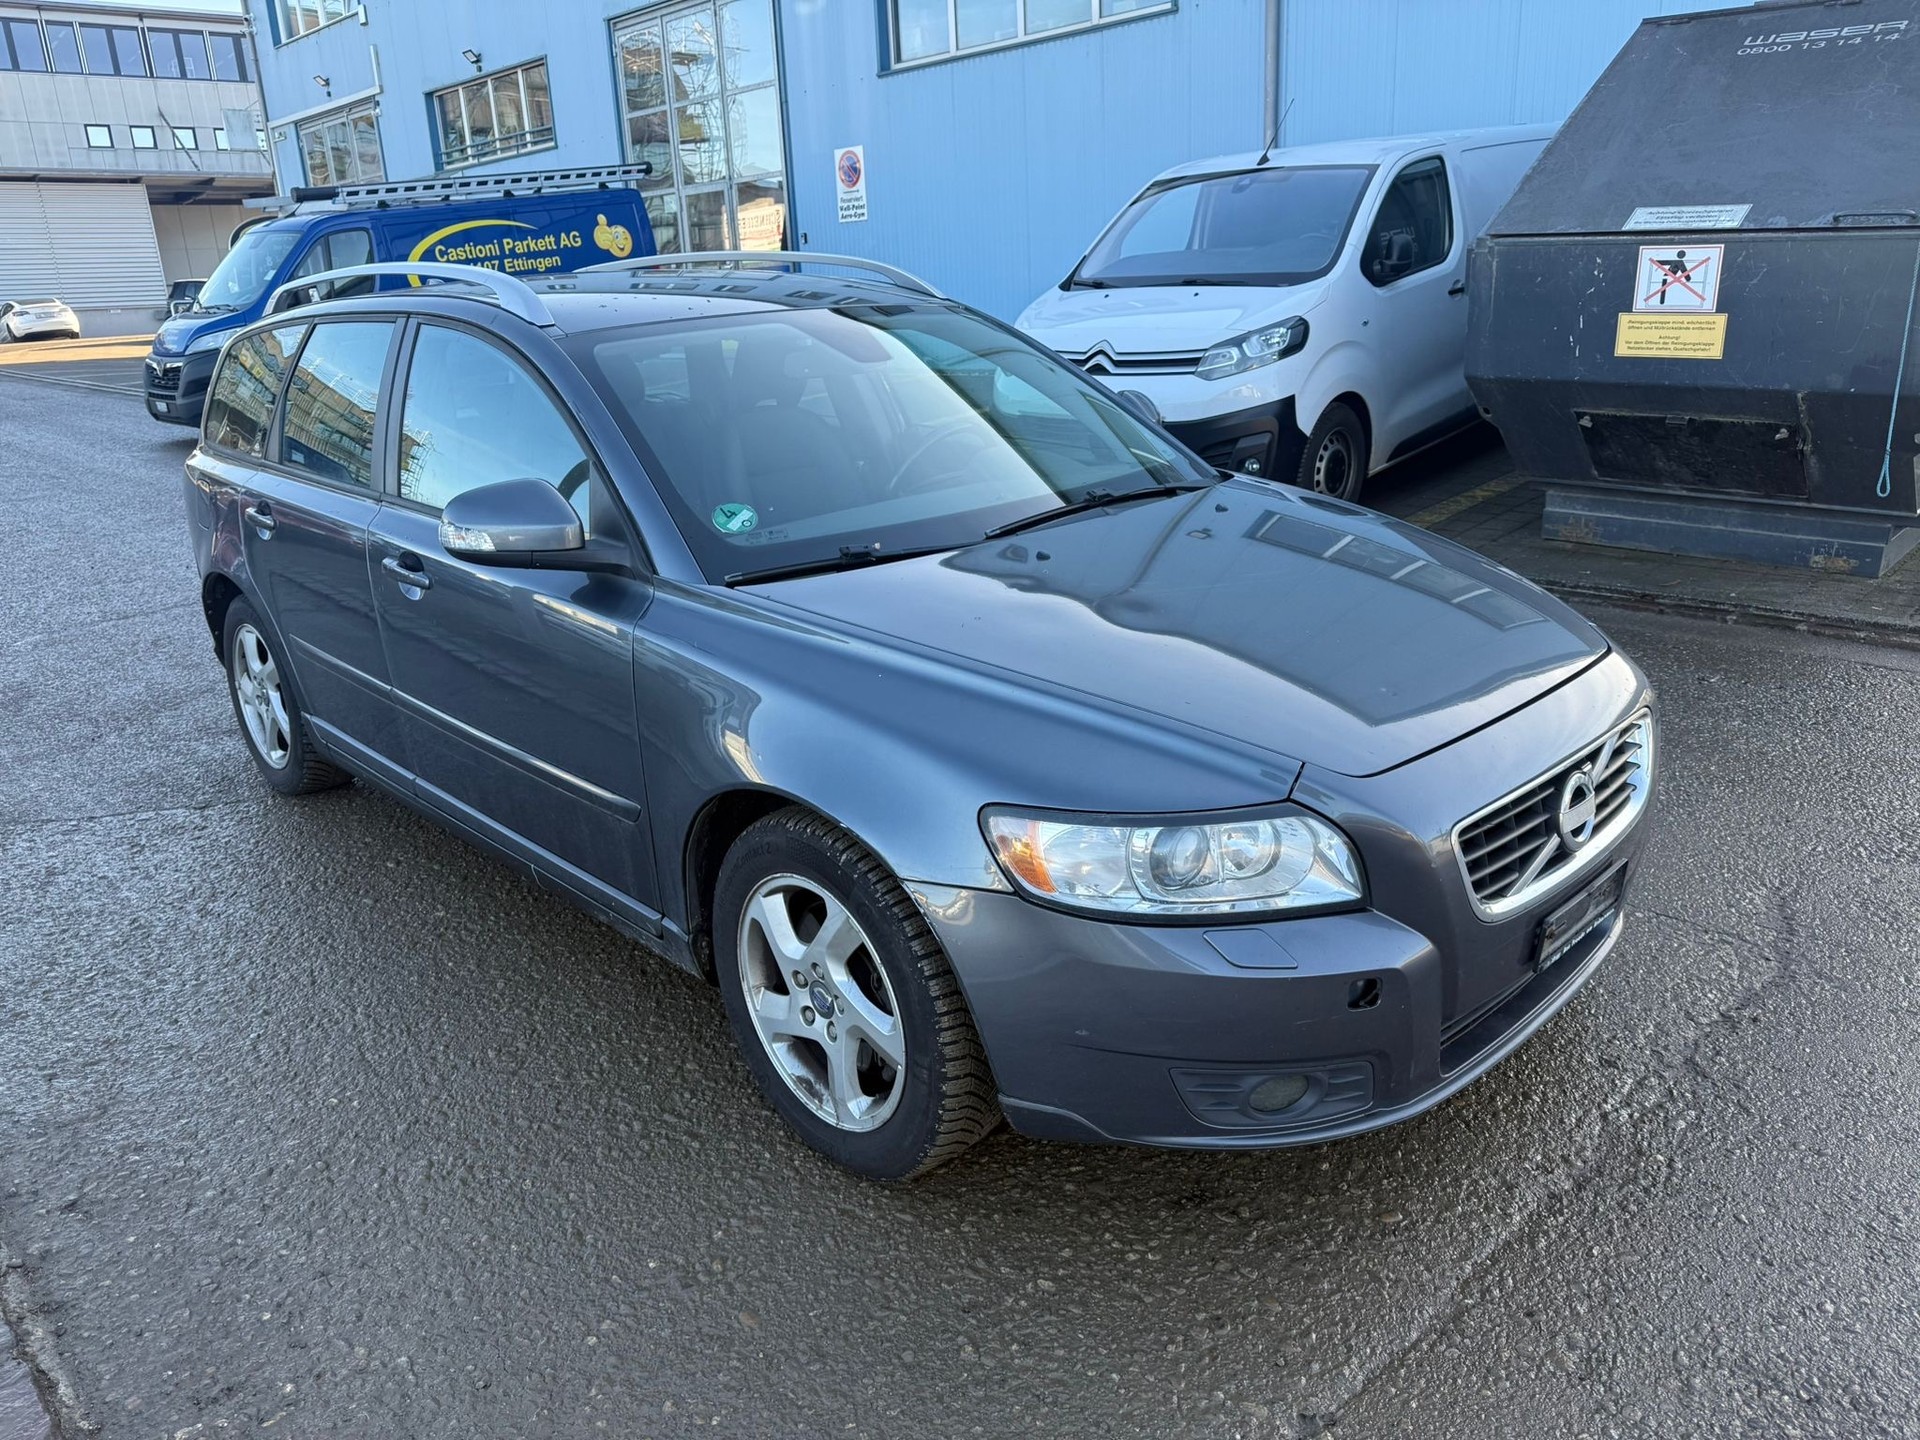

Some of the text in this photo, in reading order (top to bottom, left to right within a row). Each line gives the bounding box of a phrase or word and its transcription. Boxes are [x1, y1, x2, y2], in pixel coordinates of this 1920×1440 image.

[1736, 32, 1900, 56] 0800 13 14 14
[435, 230, 582, 262] Castioni Parkett AG
[504, 255, 562, 273] Ettingen
[720, 507, 738, 519] 4
